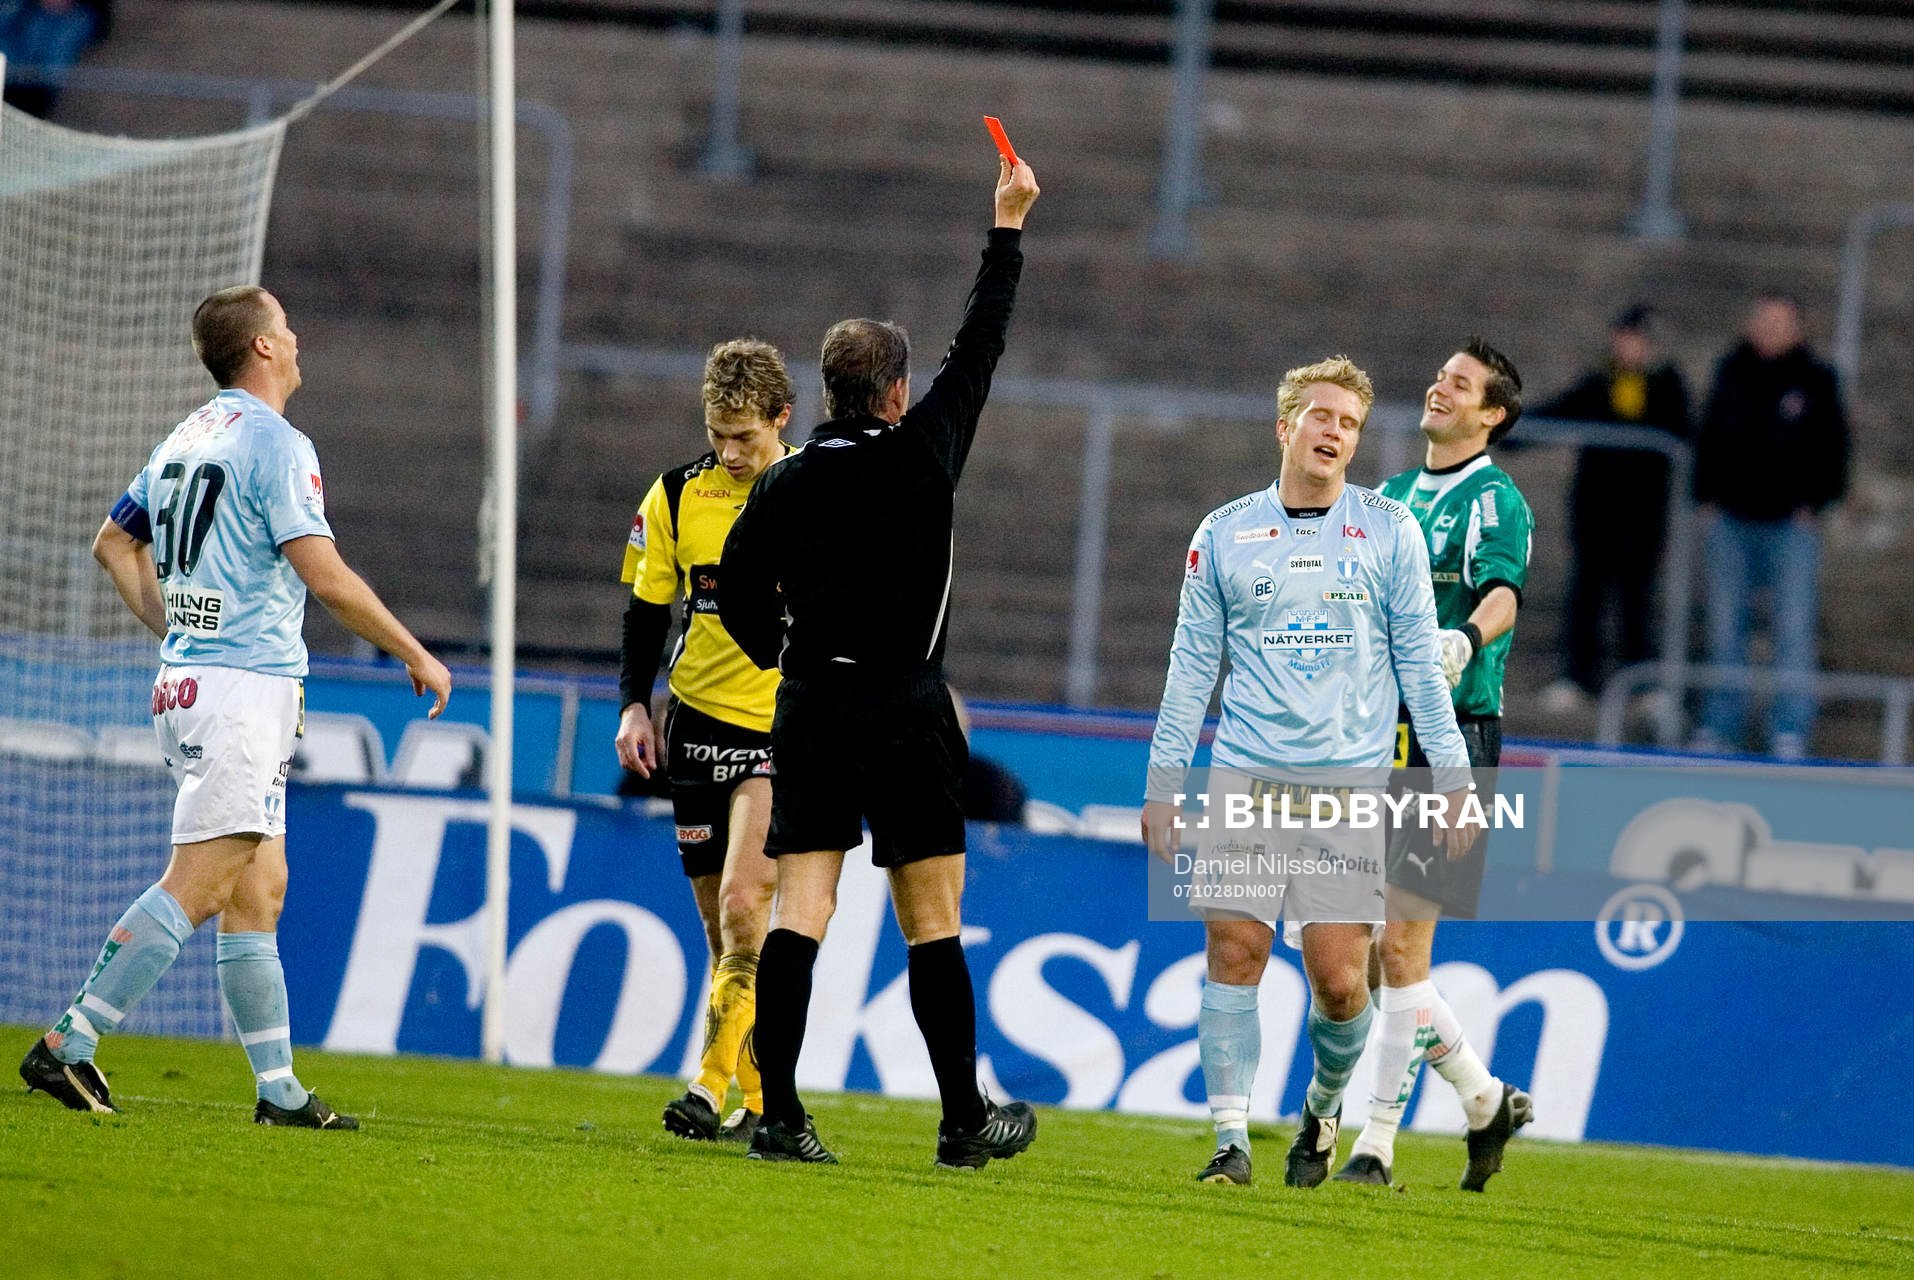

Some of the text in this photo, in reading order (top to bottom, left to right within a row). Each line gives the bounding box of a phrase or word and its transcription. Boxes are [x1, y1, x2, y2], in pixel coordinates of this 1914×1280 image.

[1360, 491, 1409, 523] STADIUM
[156, 463, 226, 579] 30
[1342, 525, 1367, 539] ICA
[1255, 581, 1273, 597] BE
[1330, 592, 1364, 600] PEAB
[1263, 633, 1353, 646] NÄTVERKET
[680, 830, 708, 840] BYGG
